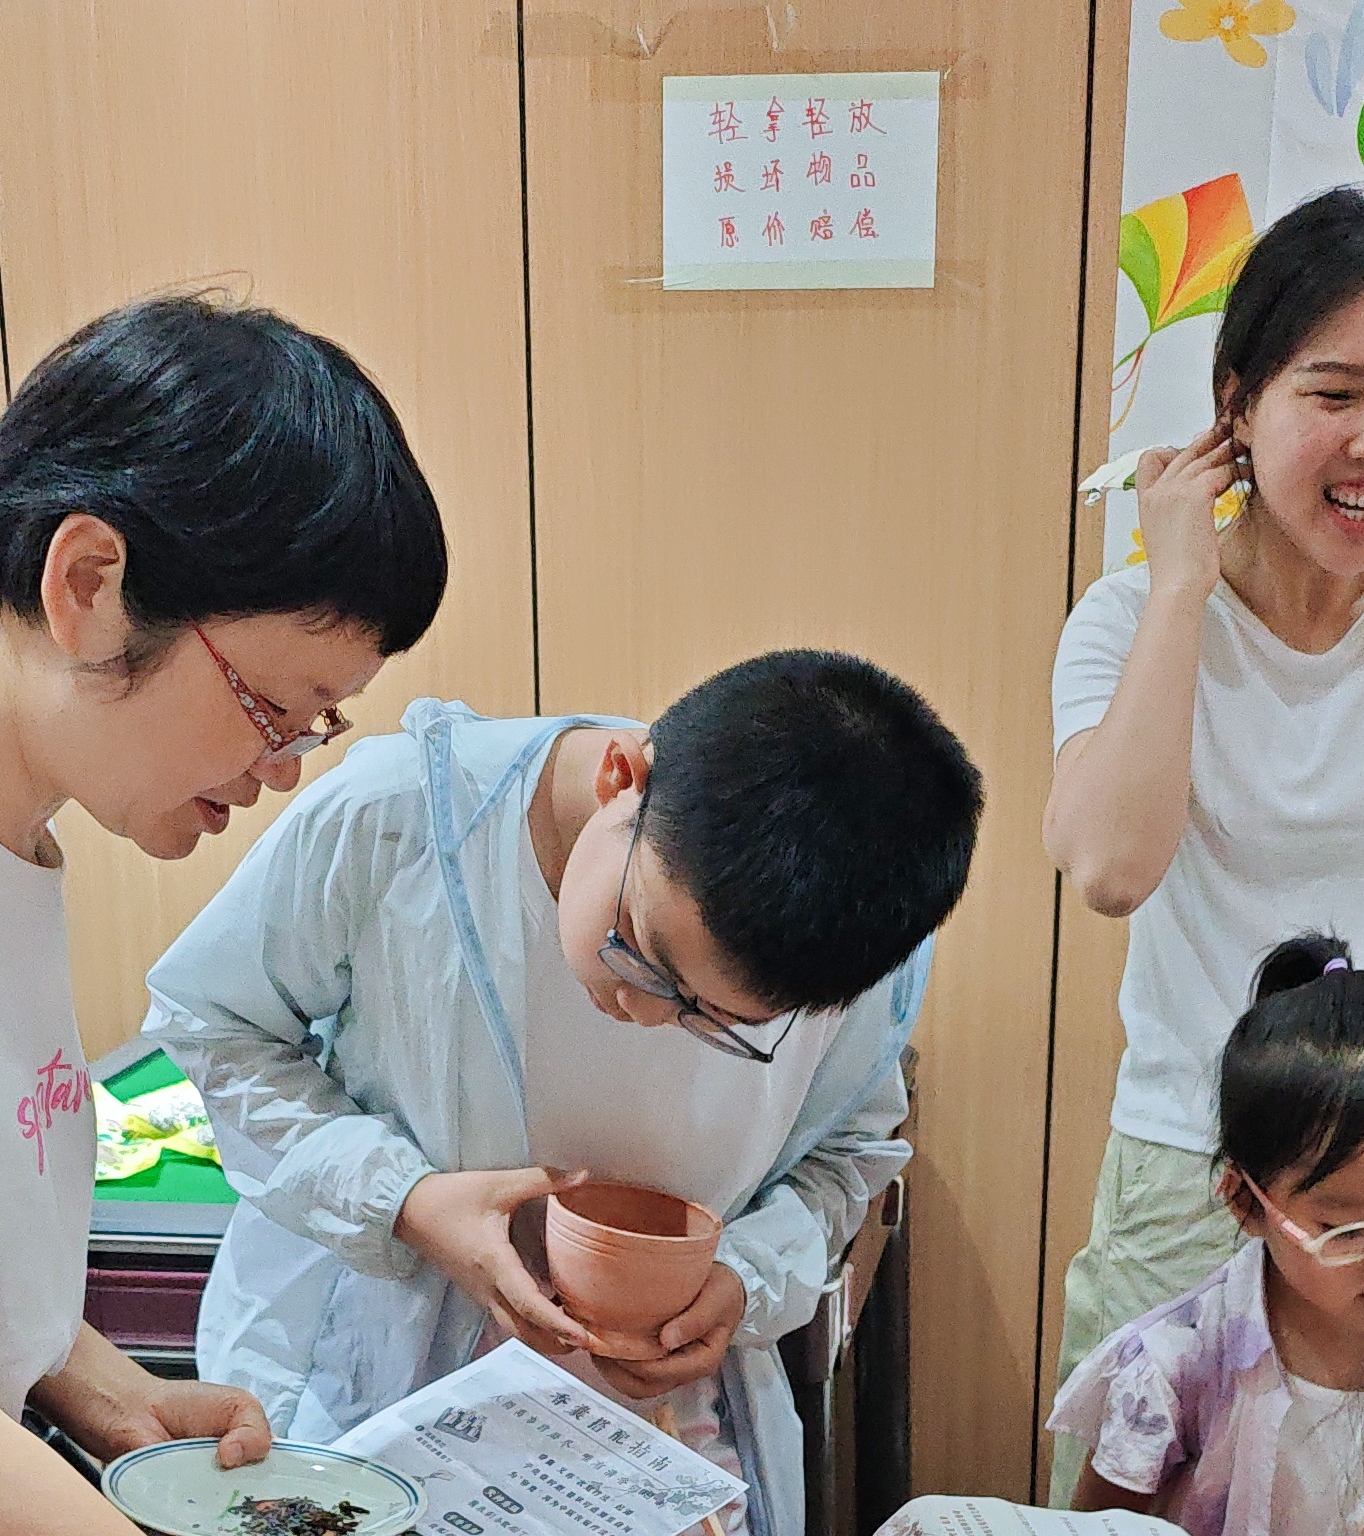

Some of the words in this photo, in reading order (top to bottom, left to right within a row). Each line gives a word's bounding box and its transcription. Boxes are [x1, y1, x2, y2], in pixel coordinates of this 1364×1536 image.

[708, 96, 887, 143] 轻拿轻放
[714, 151, 876, 193] 损坏物品
[716, 208, 881, 249] 原价赔偿
